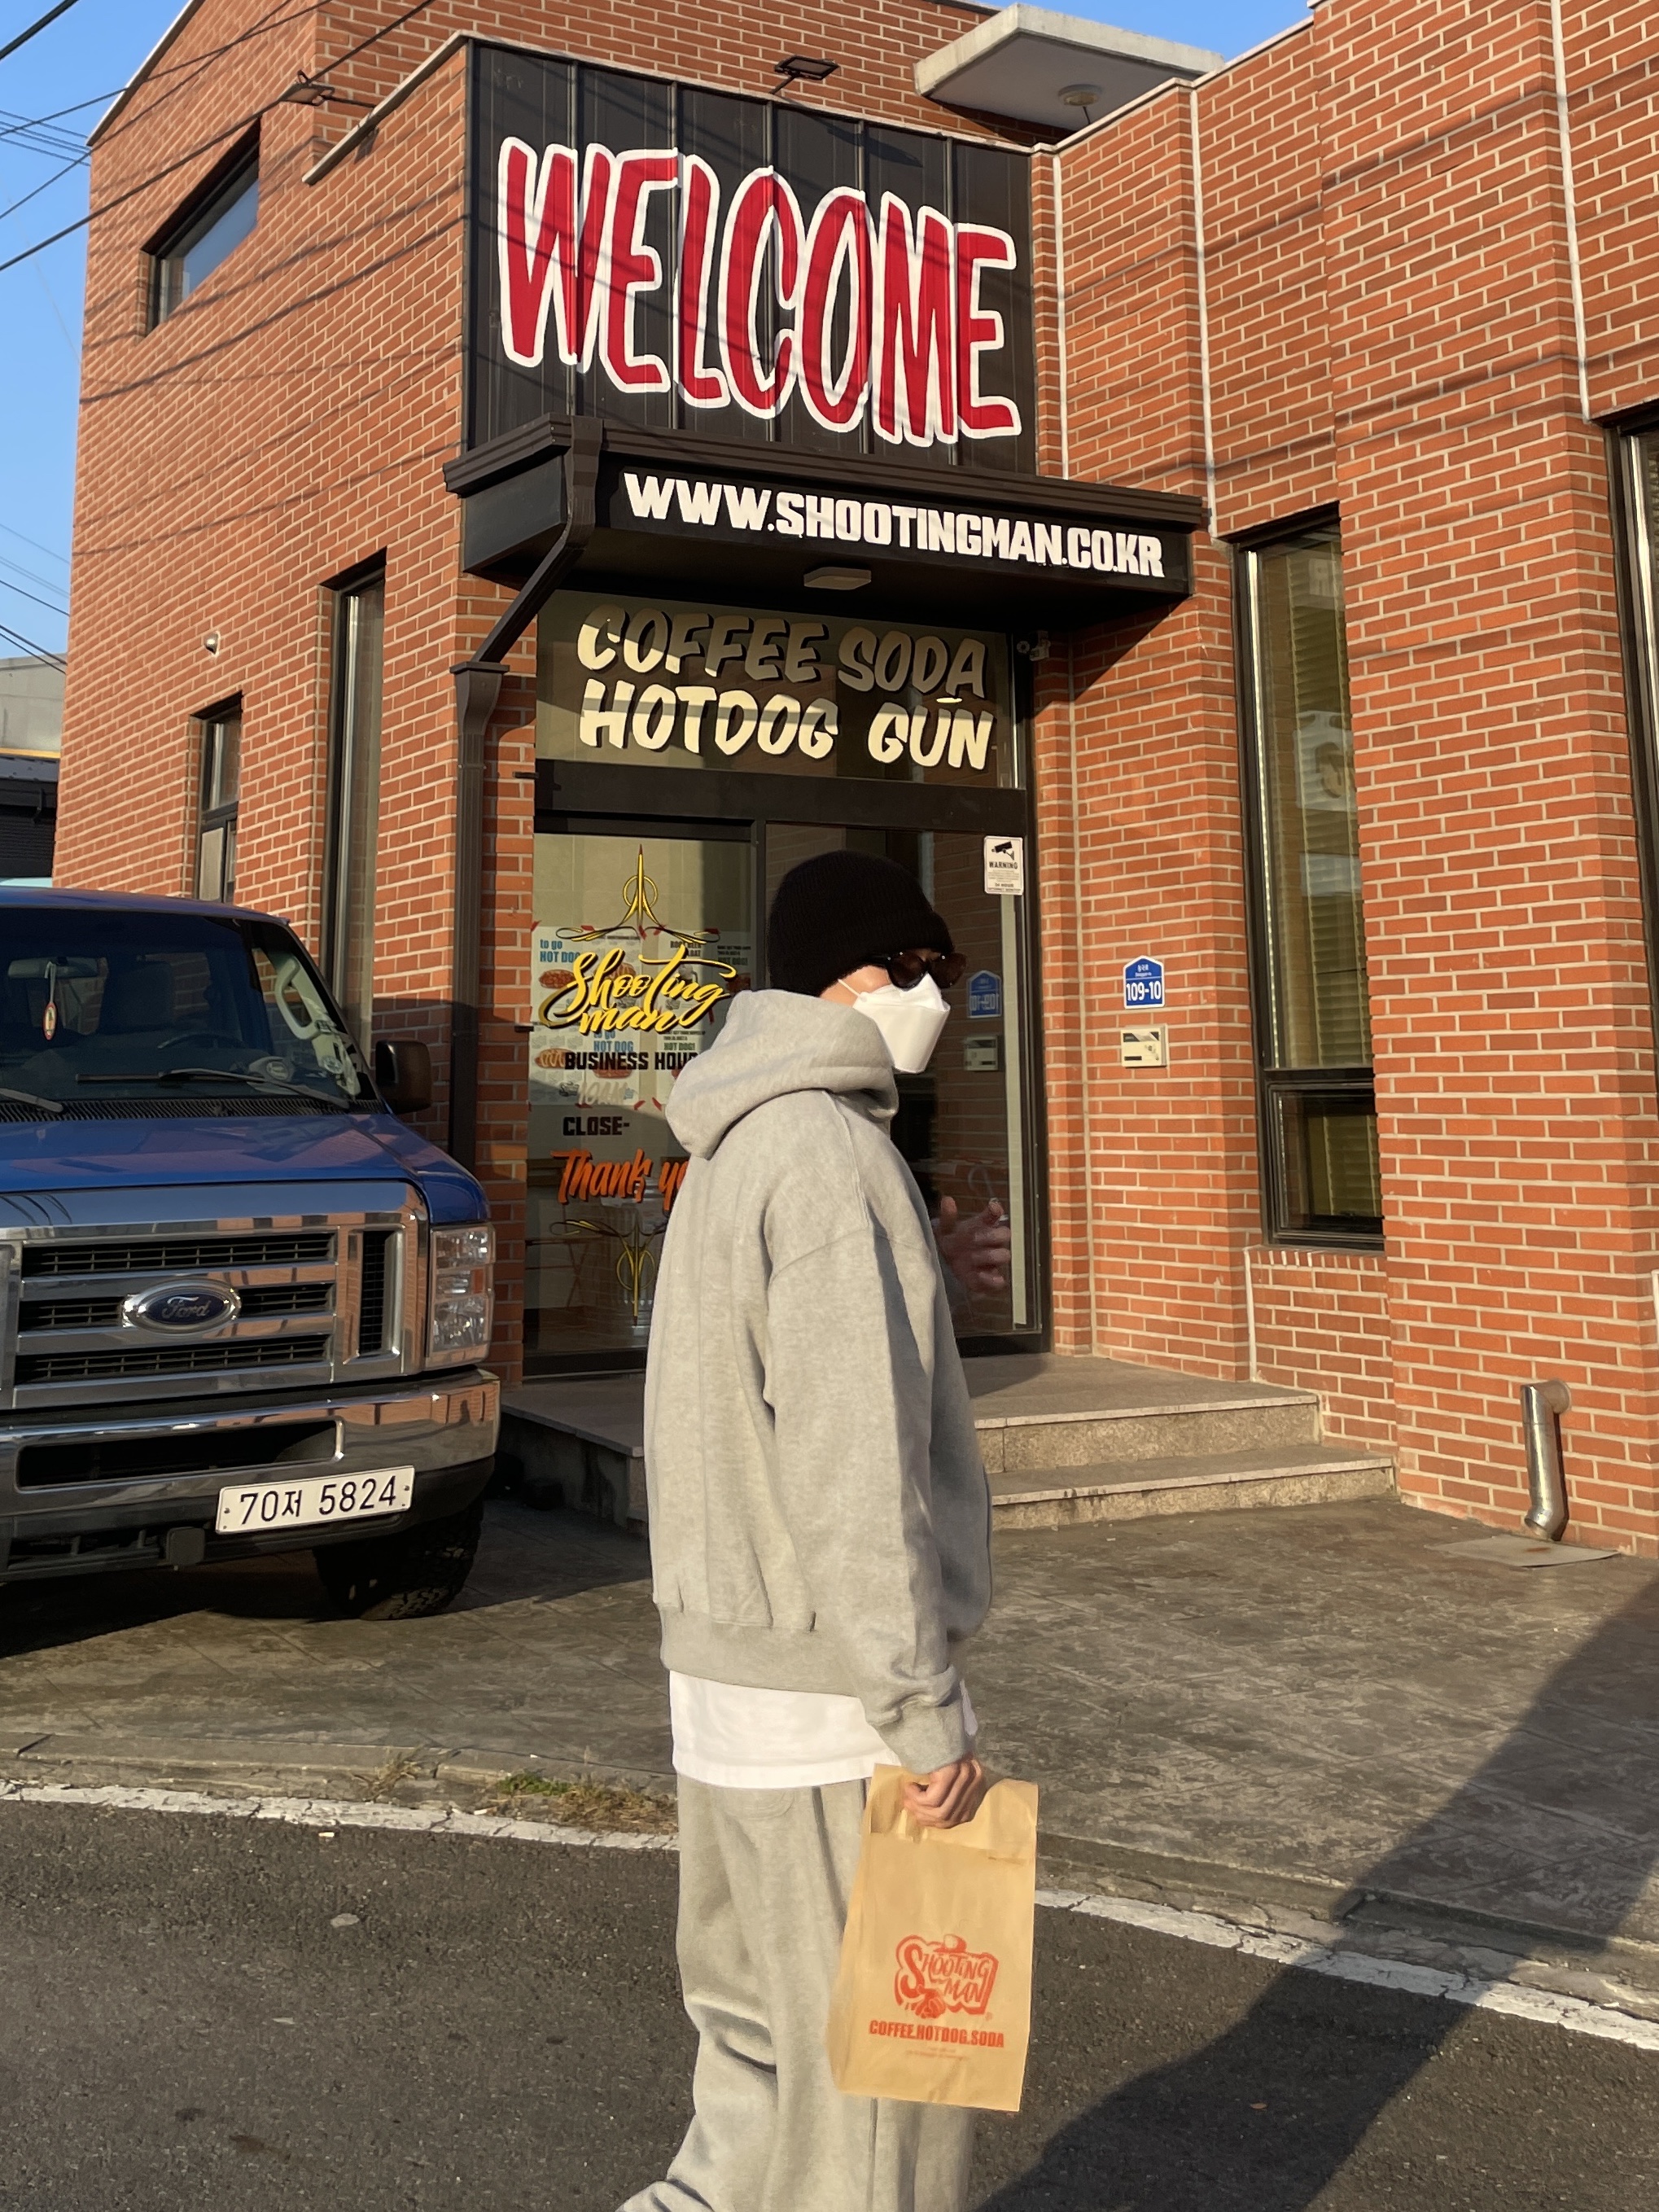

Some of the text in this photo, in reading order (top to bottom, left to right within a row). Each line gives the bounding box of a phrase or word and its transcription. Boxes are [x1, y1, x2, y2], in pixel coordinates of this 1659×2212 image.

[497, 136, 1022, 447] WELCOME
[624, 472, 1165, 578] WWW.SHOOTINGMAN.CO.KR
[577, 603, 986, 698] COFFEE SODA
[580, 678, 995, 770] HOTDOG GUN
[989, 861, 1018, 869] WARNING
[540, 939, 563, 950] to go
[540, 951, 559, 963] HOT
[538, 944, 738, 1030] Shooting
[1126, 980, 1162, 1001] 109-10
[578, 1005, 682, 1035] man
[564, 1052, 649, 1070] BUSINESS
[593, 1040, 634, 1052] HOT DOG
[550, 1148, 653, 1204] Thank
[162, 1296, 212, 1318] Ford
[240, 1475, 397, 1525] 70저 5824
